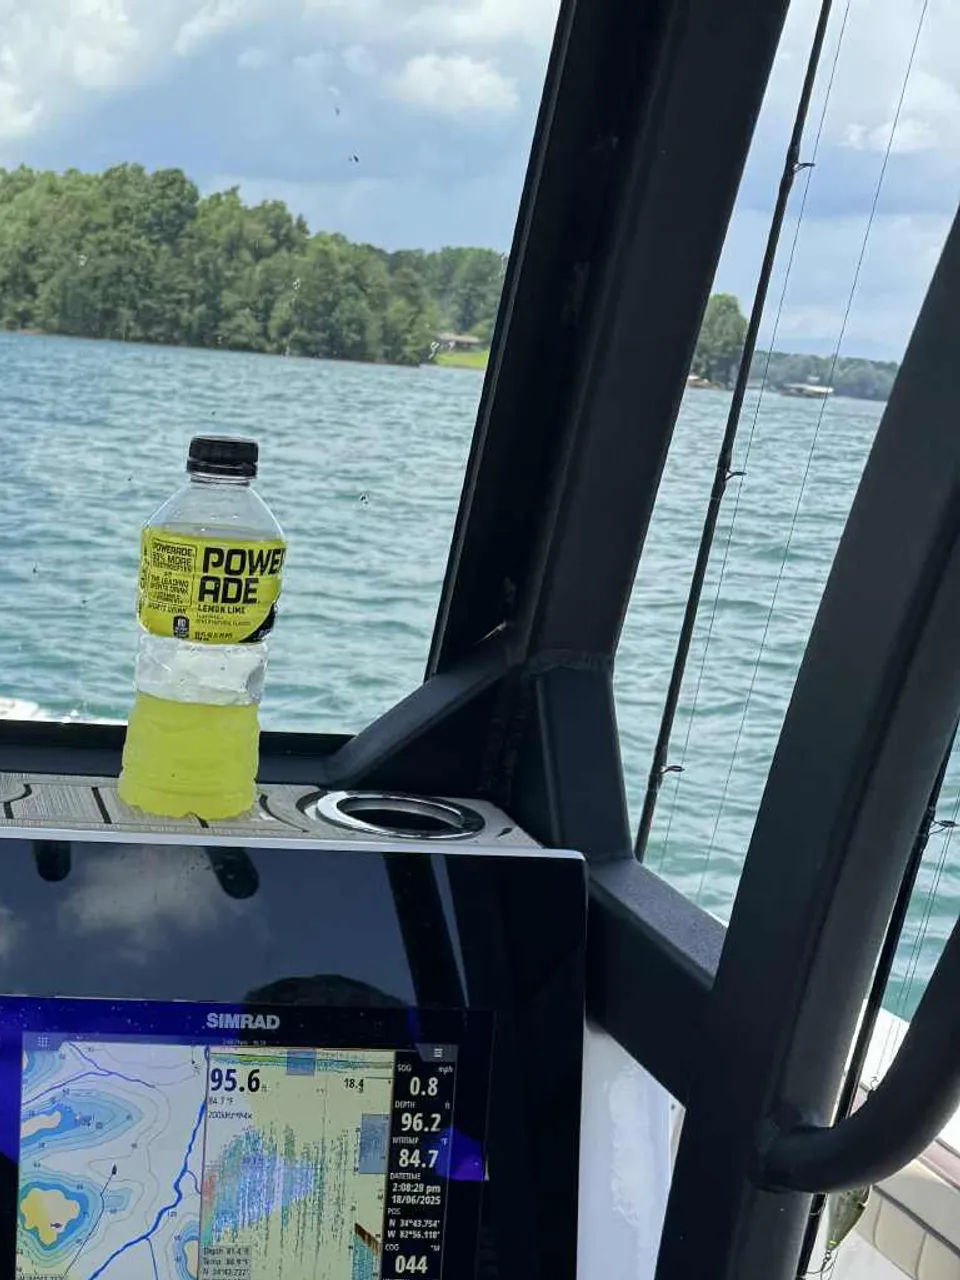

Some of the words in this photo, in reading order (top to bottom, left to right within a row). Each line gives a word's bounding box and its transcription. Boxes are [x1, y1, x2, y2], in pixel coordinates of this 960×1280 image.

[167, 555, 192, 566] MORE
[198, 576, 260, 604] ADE
[197, 603, 226, 614] LEMON
[227, 605, 246, 615] LIME
[206, 1013, 280, 1030] SIMRAD
[210, 1068, 260, 1093] 95.6
[410, 1077, 438, 1096] 0.8
[395, 1101, 415, 1109] DEPTH
[401, 1112, 442, 1132] 96.2
[399, 1149, 439, 1168] 84.7
[426, 1185, 441, 1195] pm
[391, 1195, 441, 1205] 18/06/2025
[388, 1220, 396, 1228] N
[387, 1230, 396, 1238] W
[395, 1255, 428, 1274] 044
